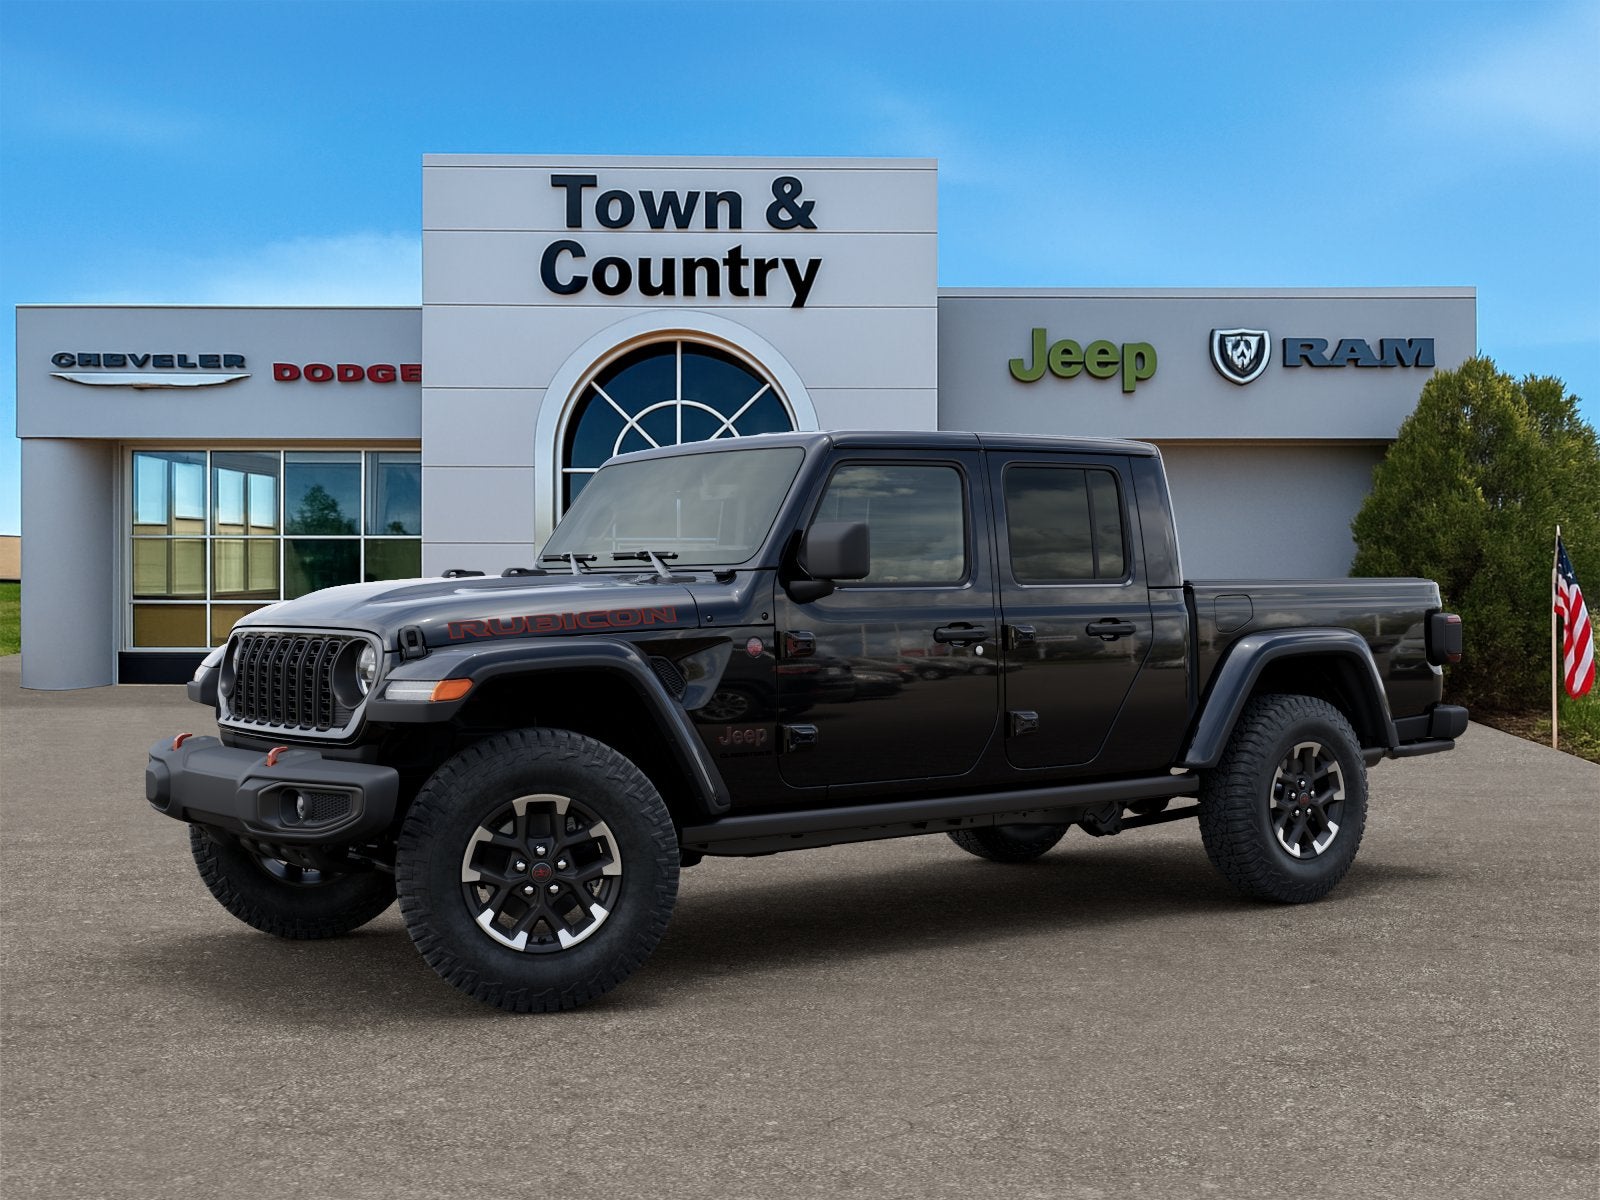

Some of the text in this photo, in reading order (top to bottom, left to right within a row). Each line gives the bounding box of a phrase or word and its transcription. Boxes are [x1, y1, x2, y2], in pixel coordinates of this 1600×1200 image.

[551, 174, 818, 230] Town &
[540, 240, 822, 308] Country
[1009, 328, 1158, 392] Jeep
[1283, 338, 1436, 367] RAM
[273, 363, 422, 382] DODGE
[449, 606, 678, 639] RUBICON
[718, 726, 768, 747] Jeep
